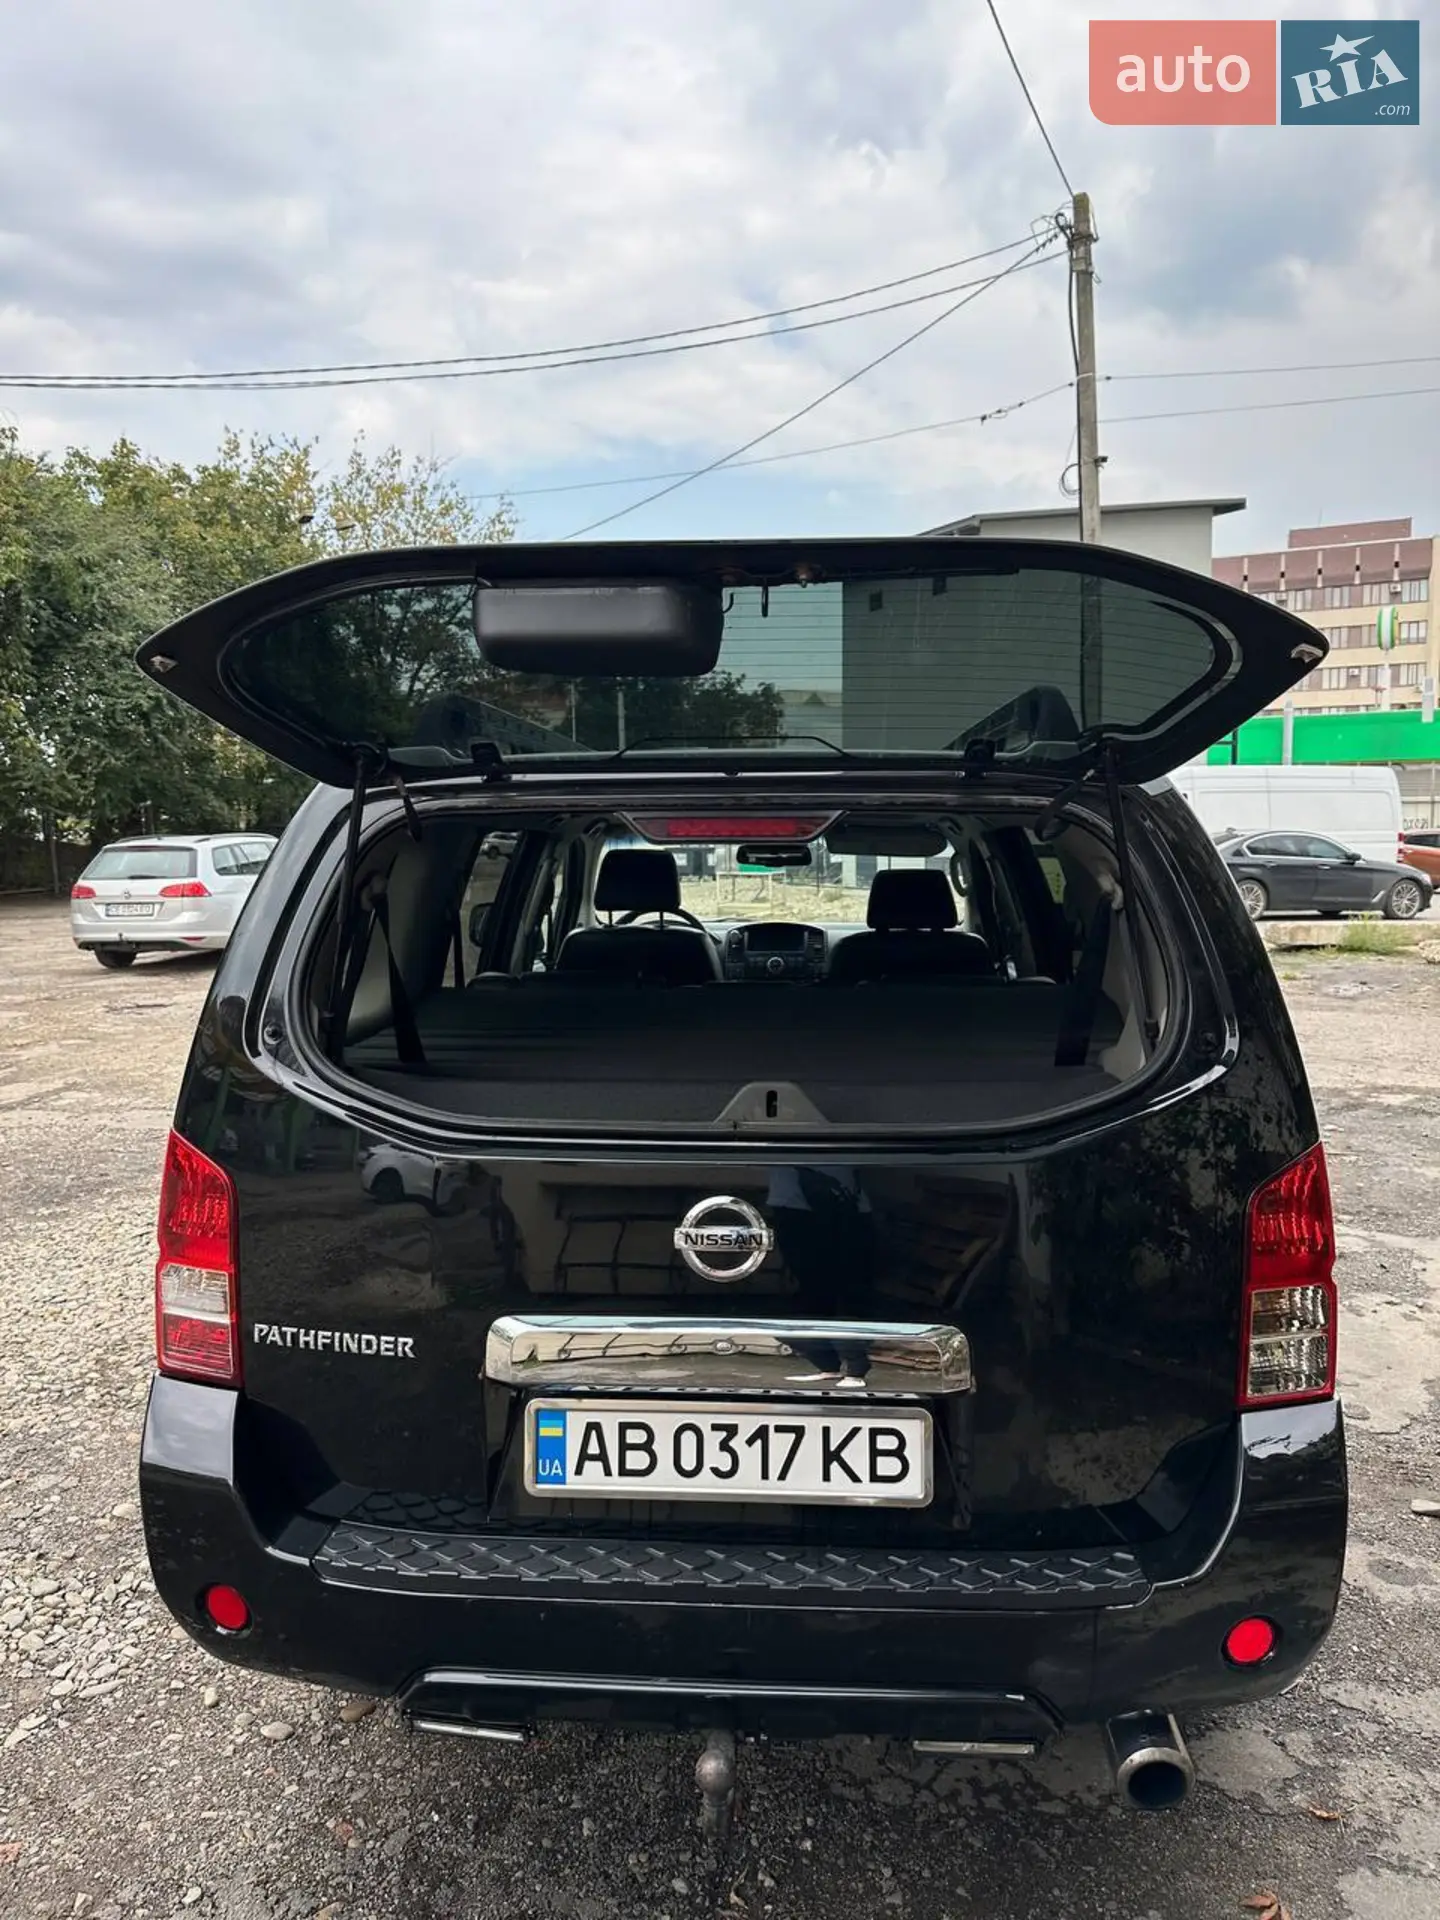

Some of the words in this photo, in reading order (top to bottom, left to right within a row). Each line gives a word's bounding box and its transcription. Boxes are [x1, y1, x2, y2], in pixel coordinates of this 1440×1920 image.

[684, 1233, 763, 1246] NISSAN
[253, 1323, 416, 1358] PATHFINDER
[573, 1421, 658, 1478] AB
[673, 1422, 806, 1481] 0317
[821, 1426, 910, 1484] KB
[538, 1459, 563, 1476] UA
